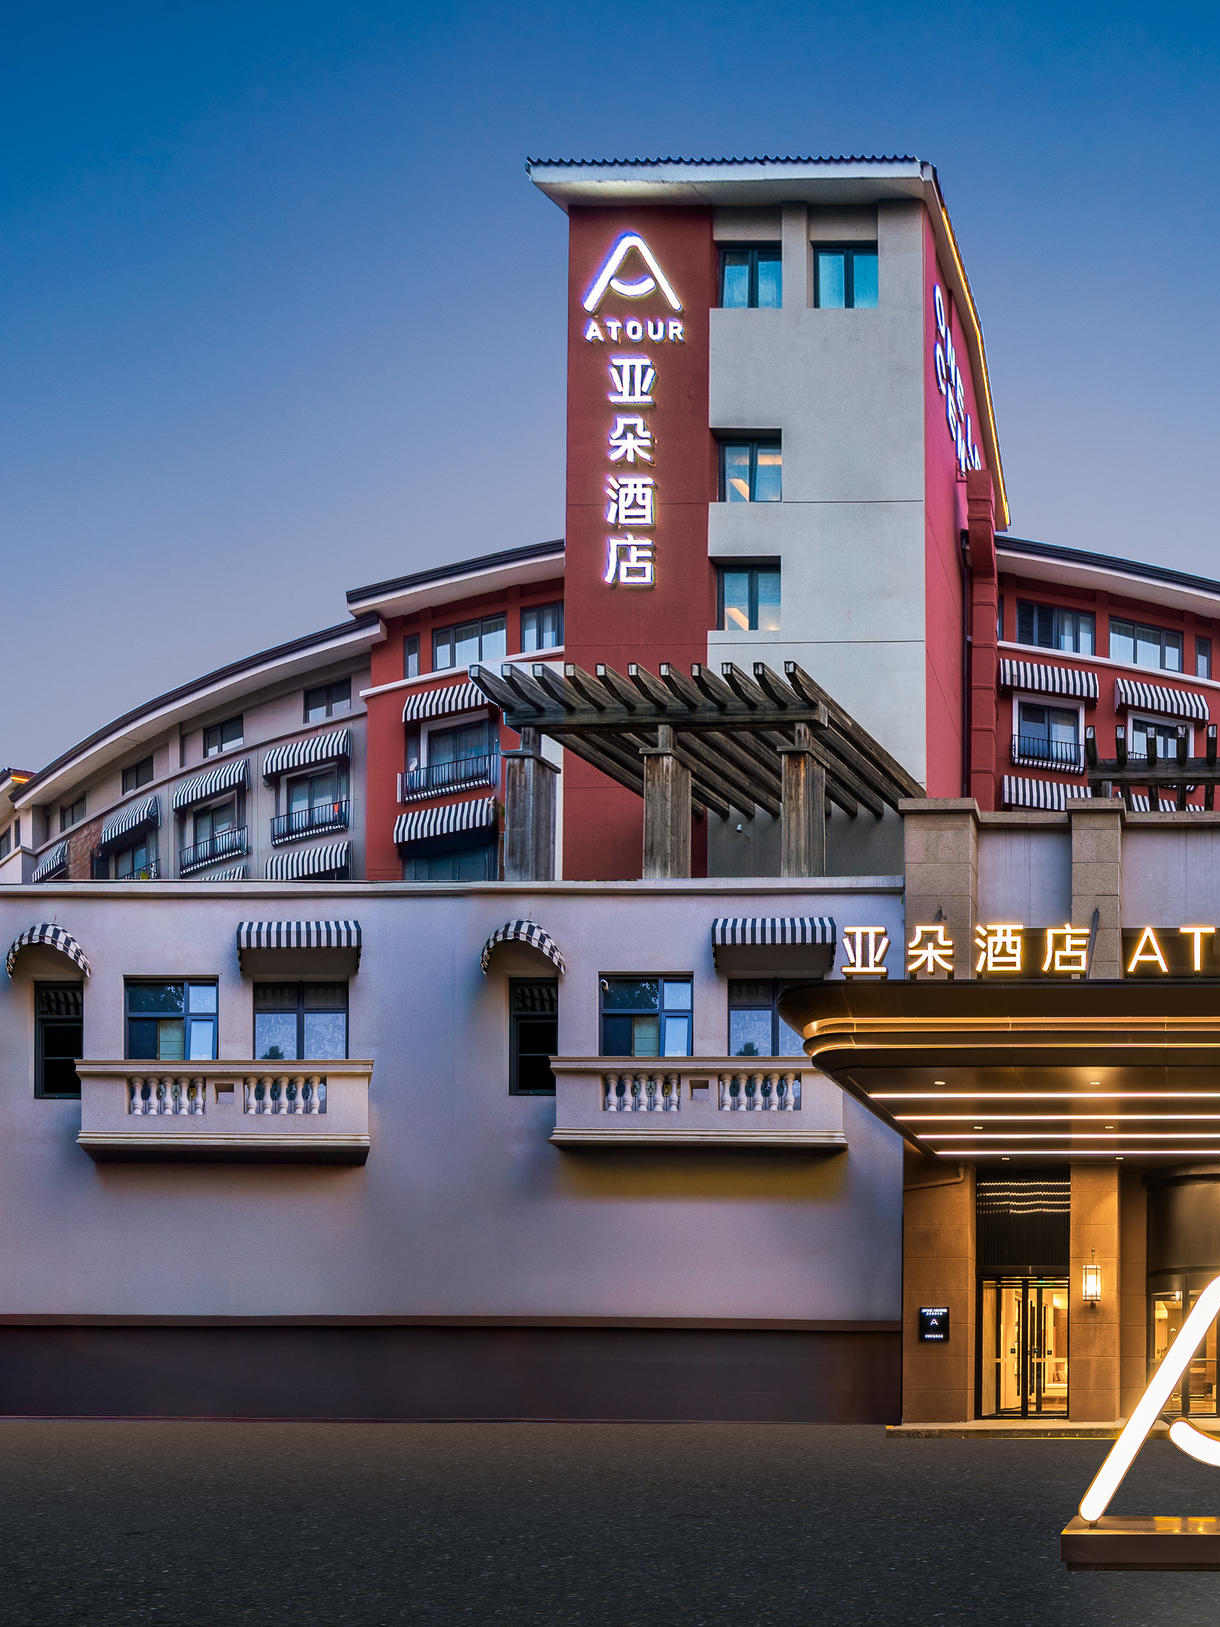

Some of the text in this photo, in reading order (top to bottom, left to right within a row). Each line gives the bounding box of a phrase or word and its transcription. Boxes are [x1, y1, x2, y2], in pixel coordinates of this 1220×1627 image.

[584, 320, 685, 342] ATOUR
[934, 341, 972, 477] CEN
[604, 355, 656, 585] 亚朵酒店
[841, 923, 1091, 973] 亚朵酒店
